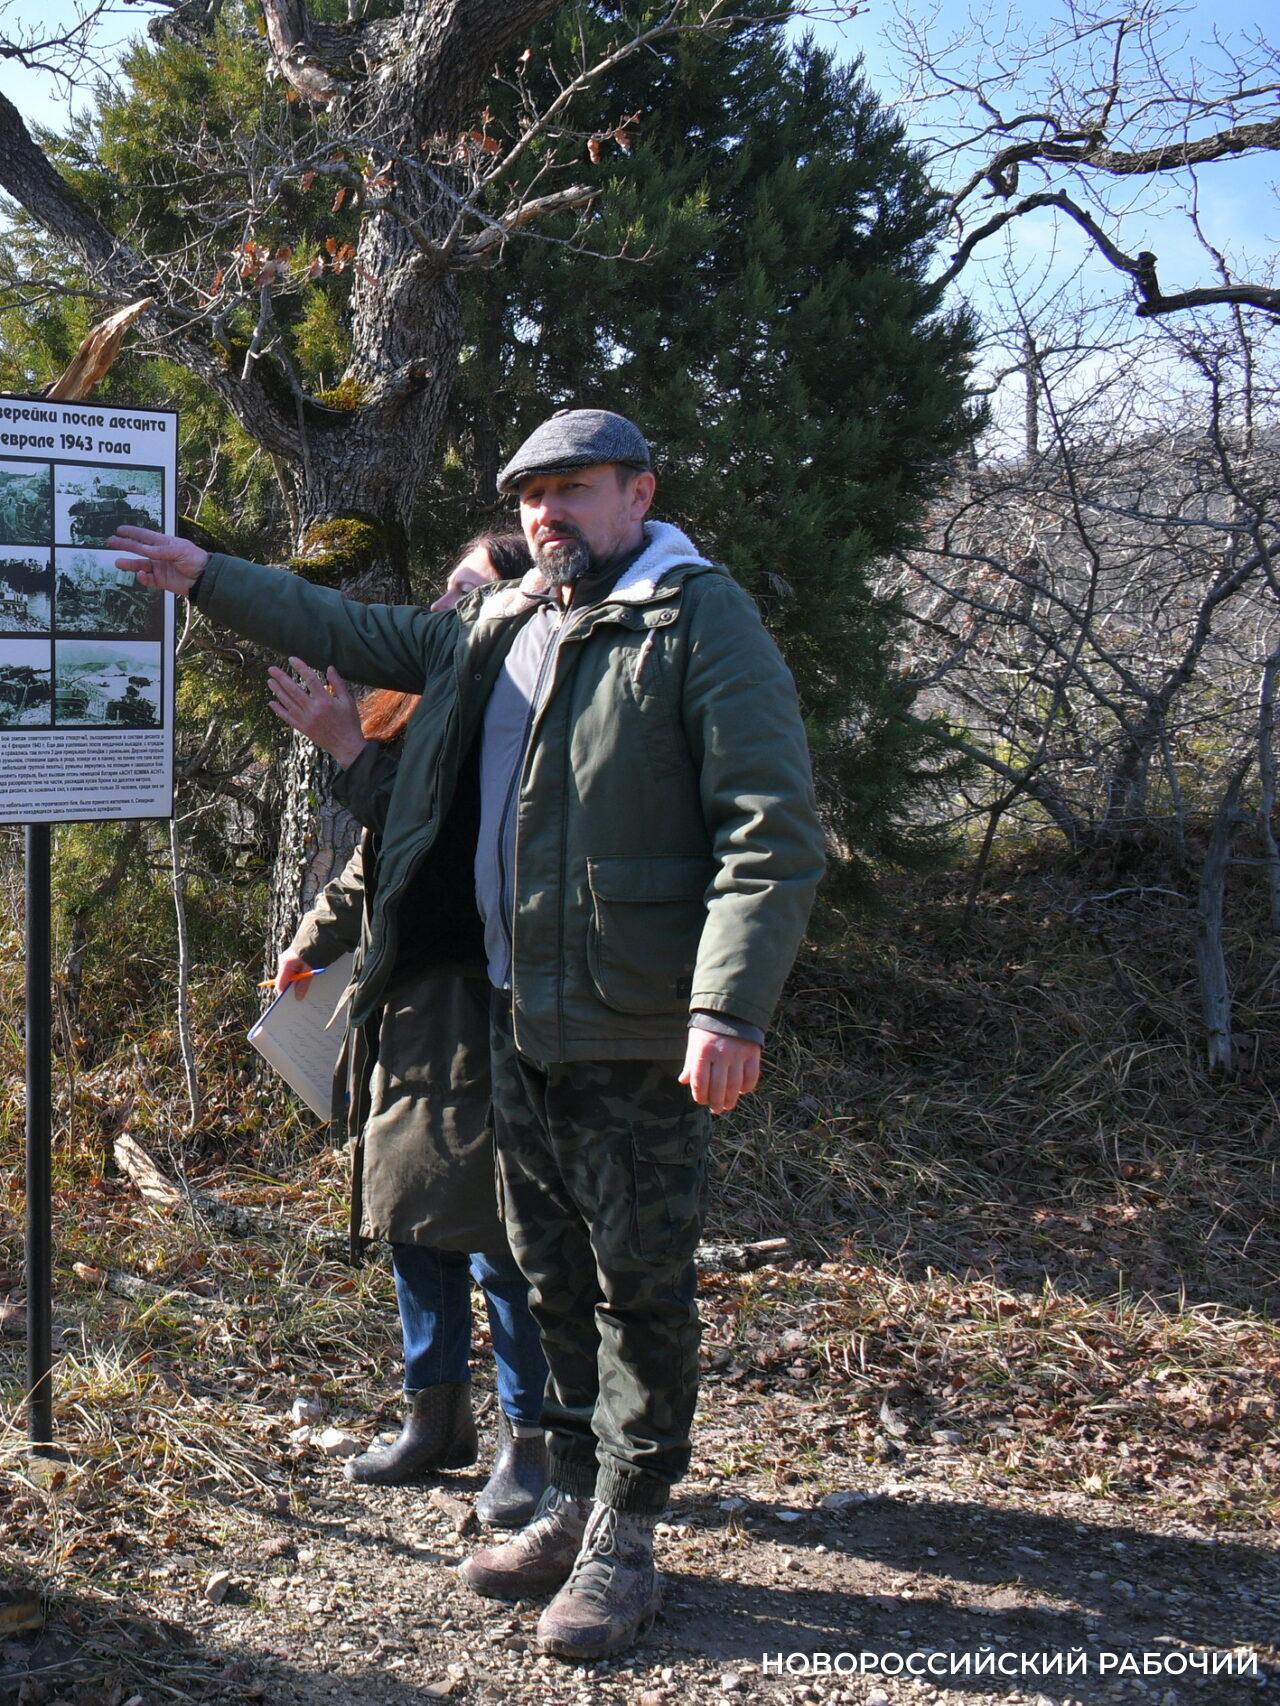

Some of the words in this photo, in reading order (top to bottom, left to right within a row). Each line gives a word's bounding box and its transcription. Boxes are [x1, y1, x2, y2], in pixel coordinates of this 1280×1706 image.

[63, 411, 104, 428] после
[109, 416, 166, 432] десанта
[60, 433, 93, 452] 1943
[98, 441, 131, 455] года
